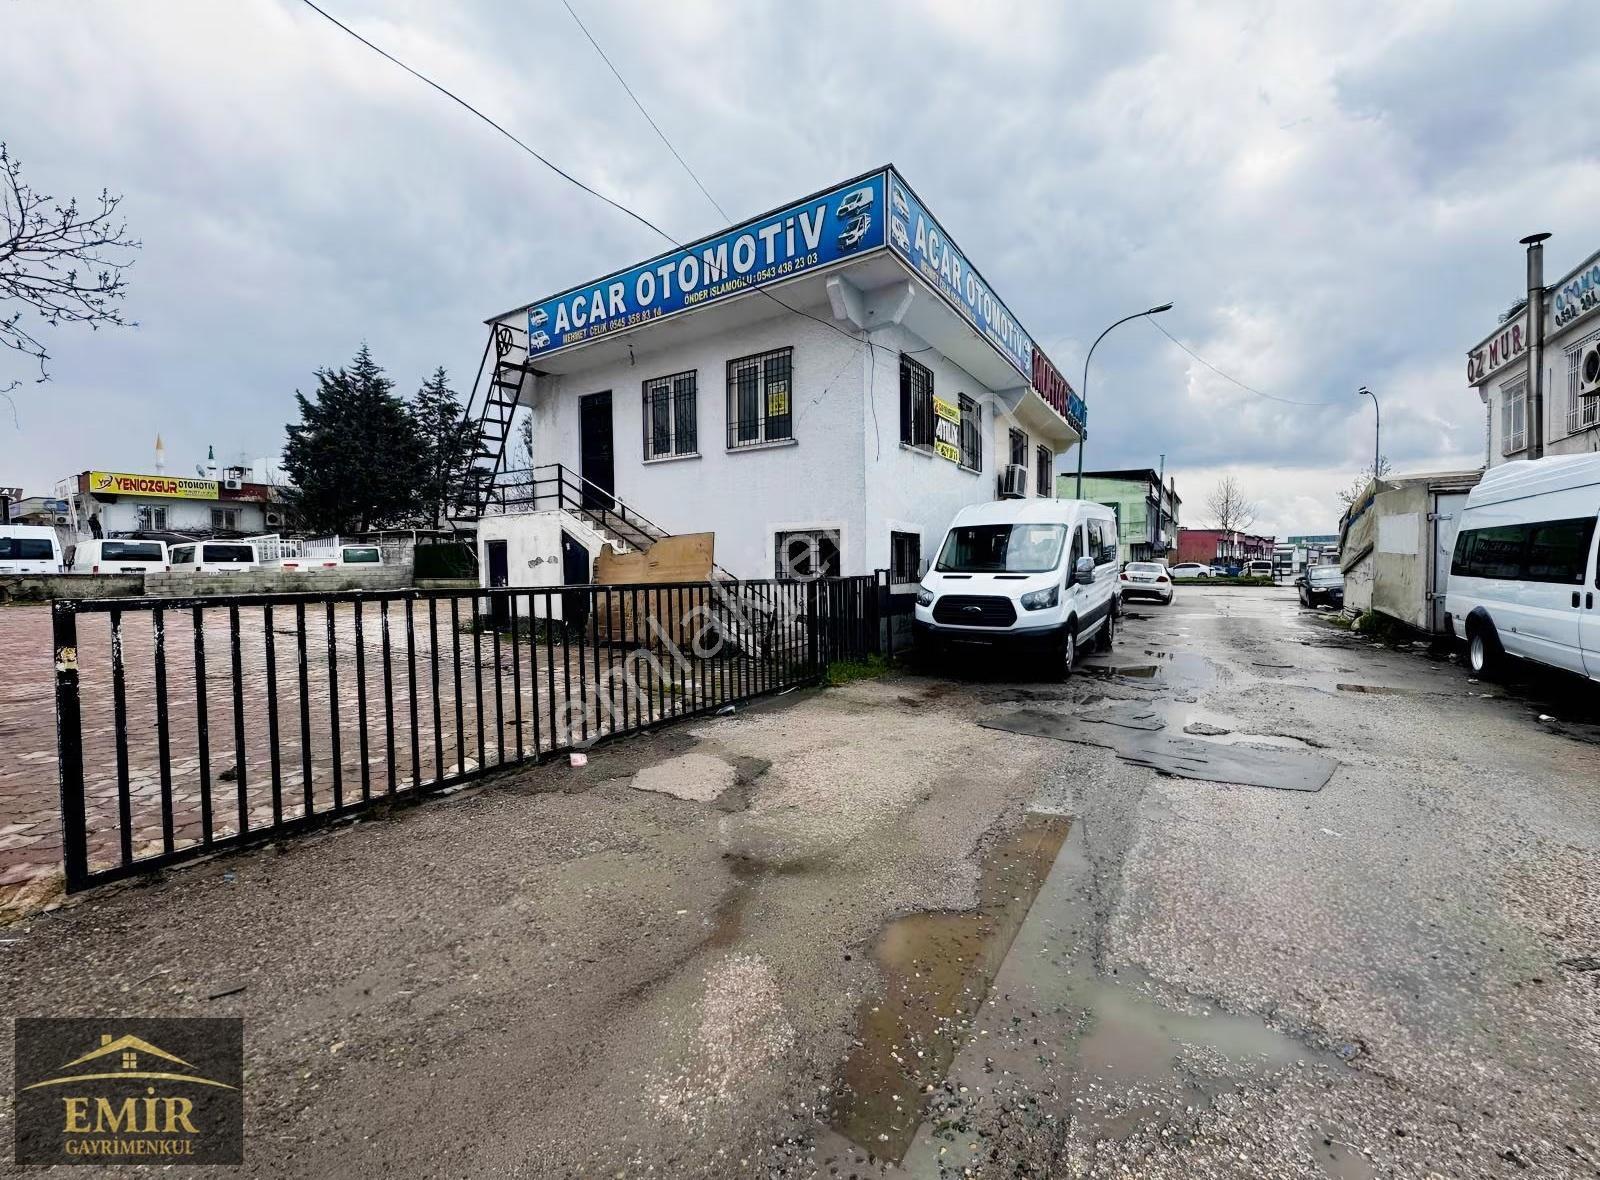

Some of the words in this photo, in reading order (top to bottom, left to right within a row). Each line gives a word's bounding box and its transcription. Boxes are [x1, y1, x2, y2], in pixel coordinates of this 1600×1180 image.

[915, 213, 962, 295] ACAR
[554, 282, 627, 335] ACAR
[1489, 324, 1524, 370] MUR
